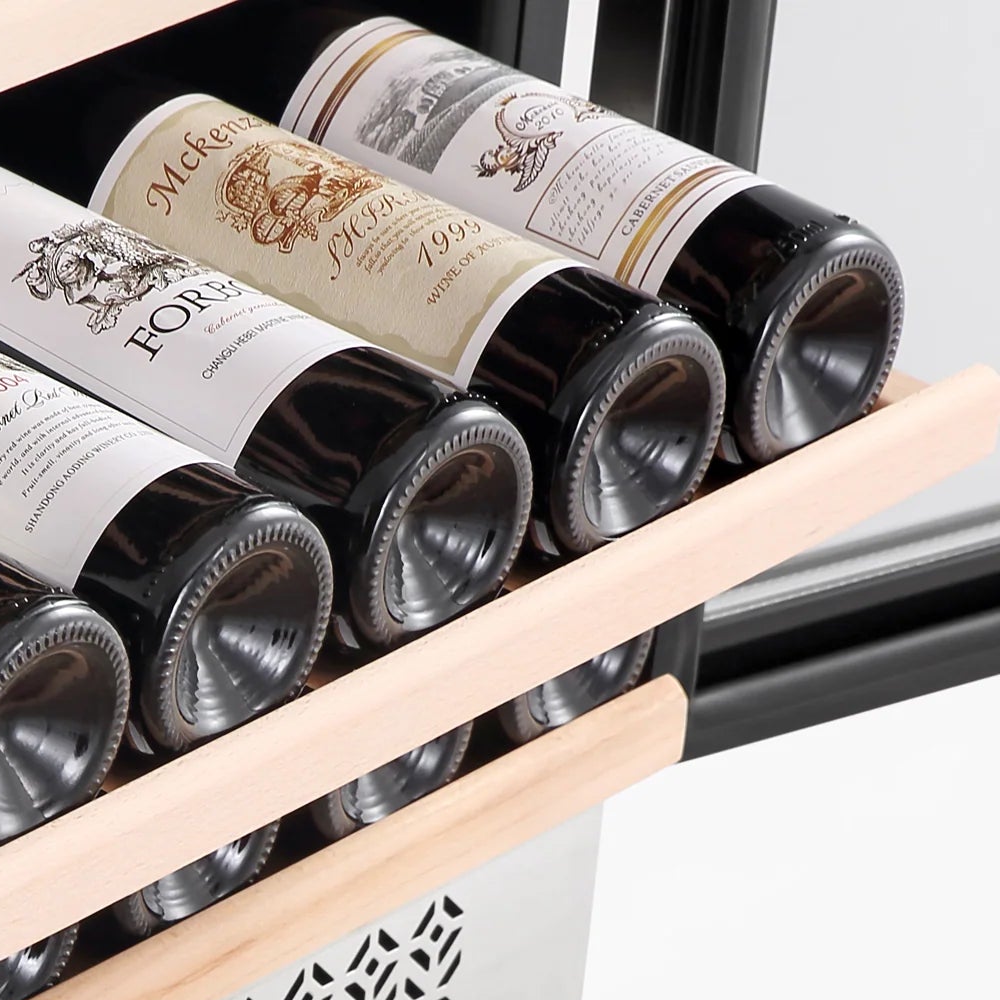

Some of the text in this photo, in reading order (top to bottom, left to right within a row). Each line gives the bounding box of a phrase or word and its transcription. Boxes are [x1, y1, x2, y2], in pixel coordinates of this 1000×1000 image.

[535, 107, 564, 131] 2010
[621, 175, 677, 238] CABERNET
[418, 219, 481, 268] 1999
[426, 265, 462, 305] WINE
[458, 251, 476, 267] OF
[204, 308, 245, 335] Cabernet
[6, 441, 17, 454] red
[16, 429, 32, 442] wine
[20, 444, 33, 458] and
[32, 433, 47, 446] with
[28, 461, 35, 469] is
[34, 442, 56, 462] clarity
[55, 432, 67, 444] and
[25, 479, 65, 534] SHANDONG
[63, 451, 96, 483] AODING
